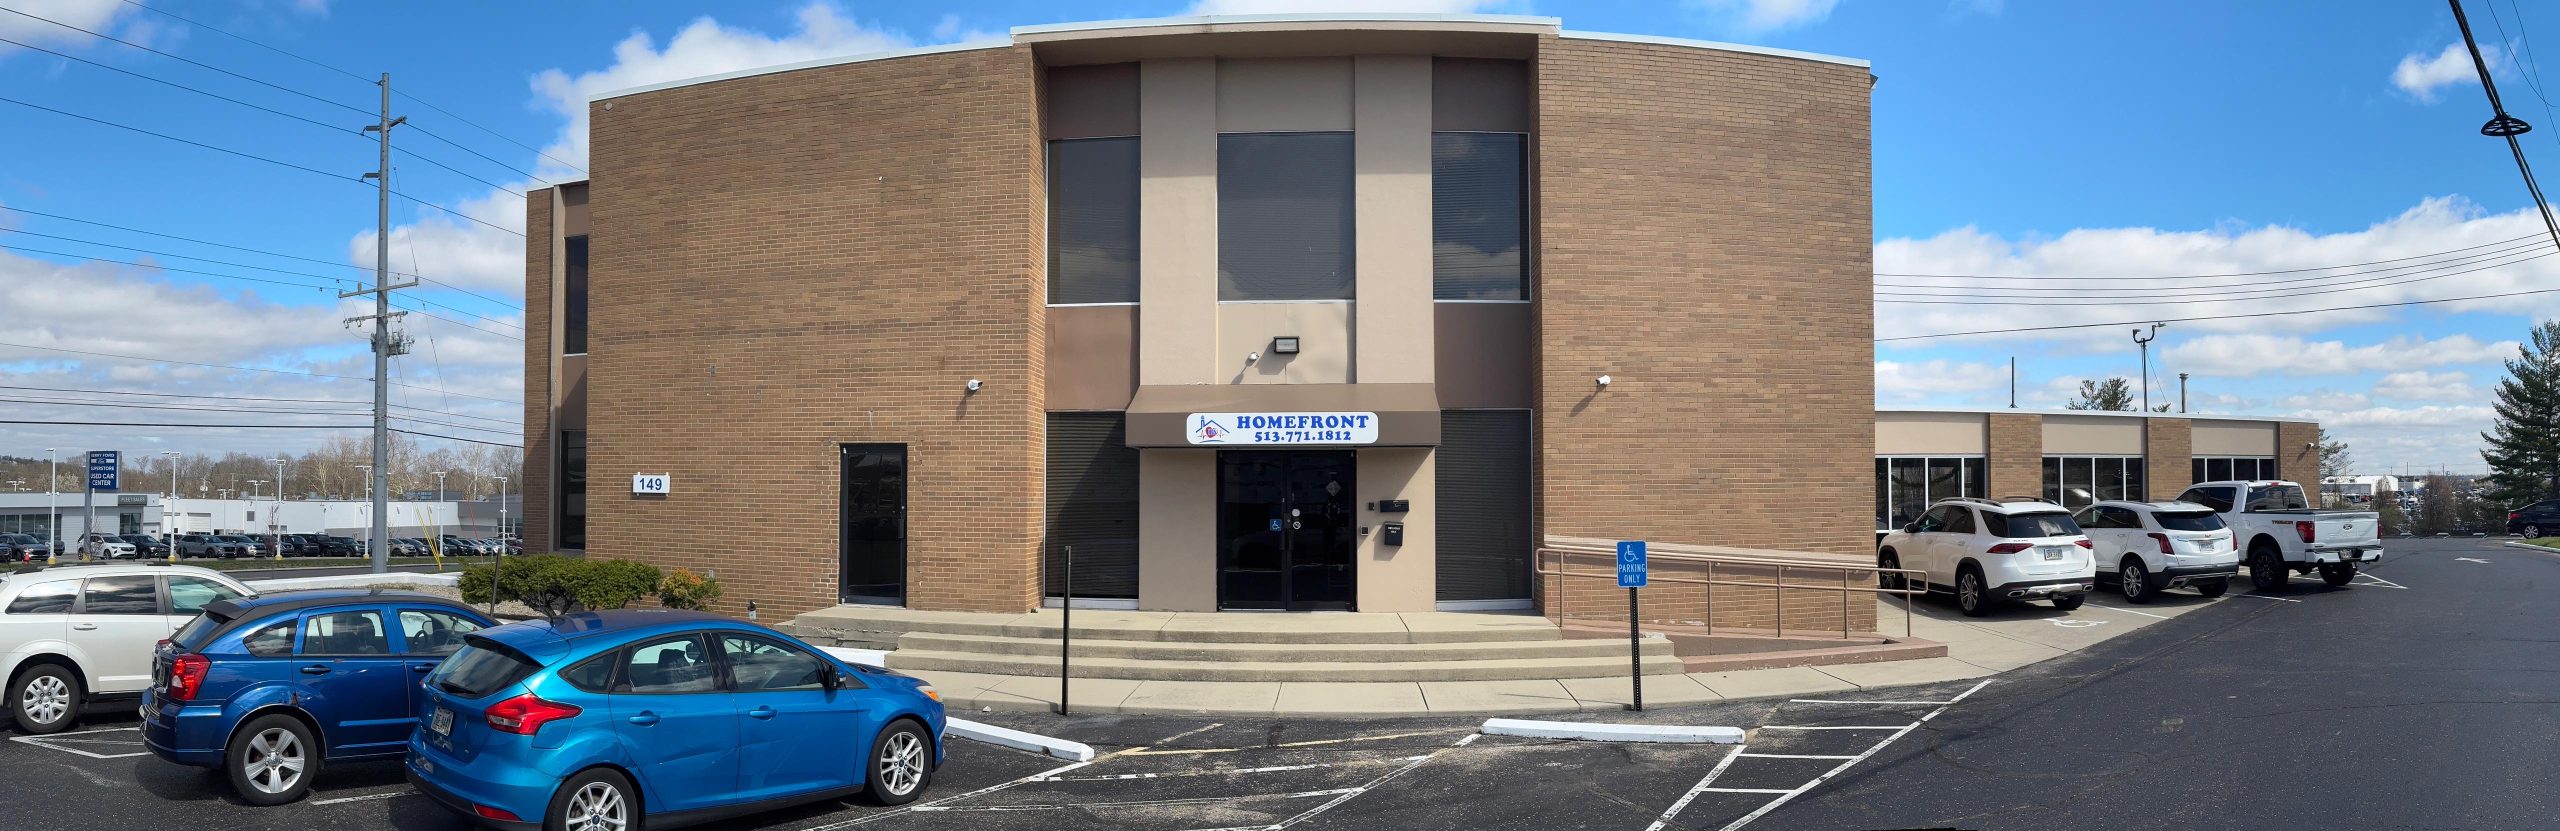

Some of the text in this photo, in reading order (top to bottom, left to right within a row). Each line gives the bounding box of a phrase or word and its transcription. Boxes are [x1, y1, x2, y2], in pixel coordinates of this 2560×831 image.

[1237, 415, 1369, 429] HOMEFRONT
[1254, 430, 1352, 442] 513.771.1812
[639, 478, 662, 491] 149
[1618, 564, 1645, 573] PARKING
[1624, 574, 1640, 584] ONLY
